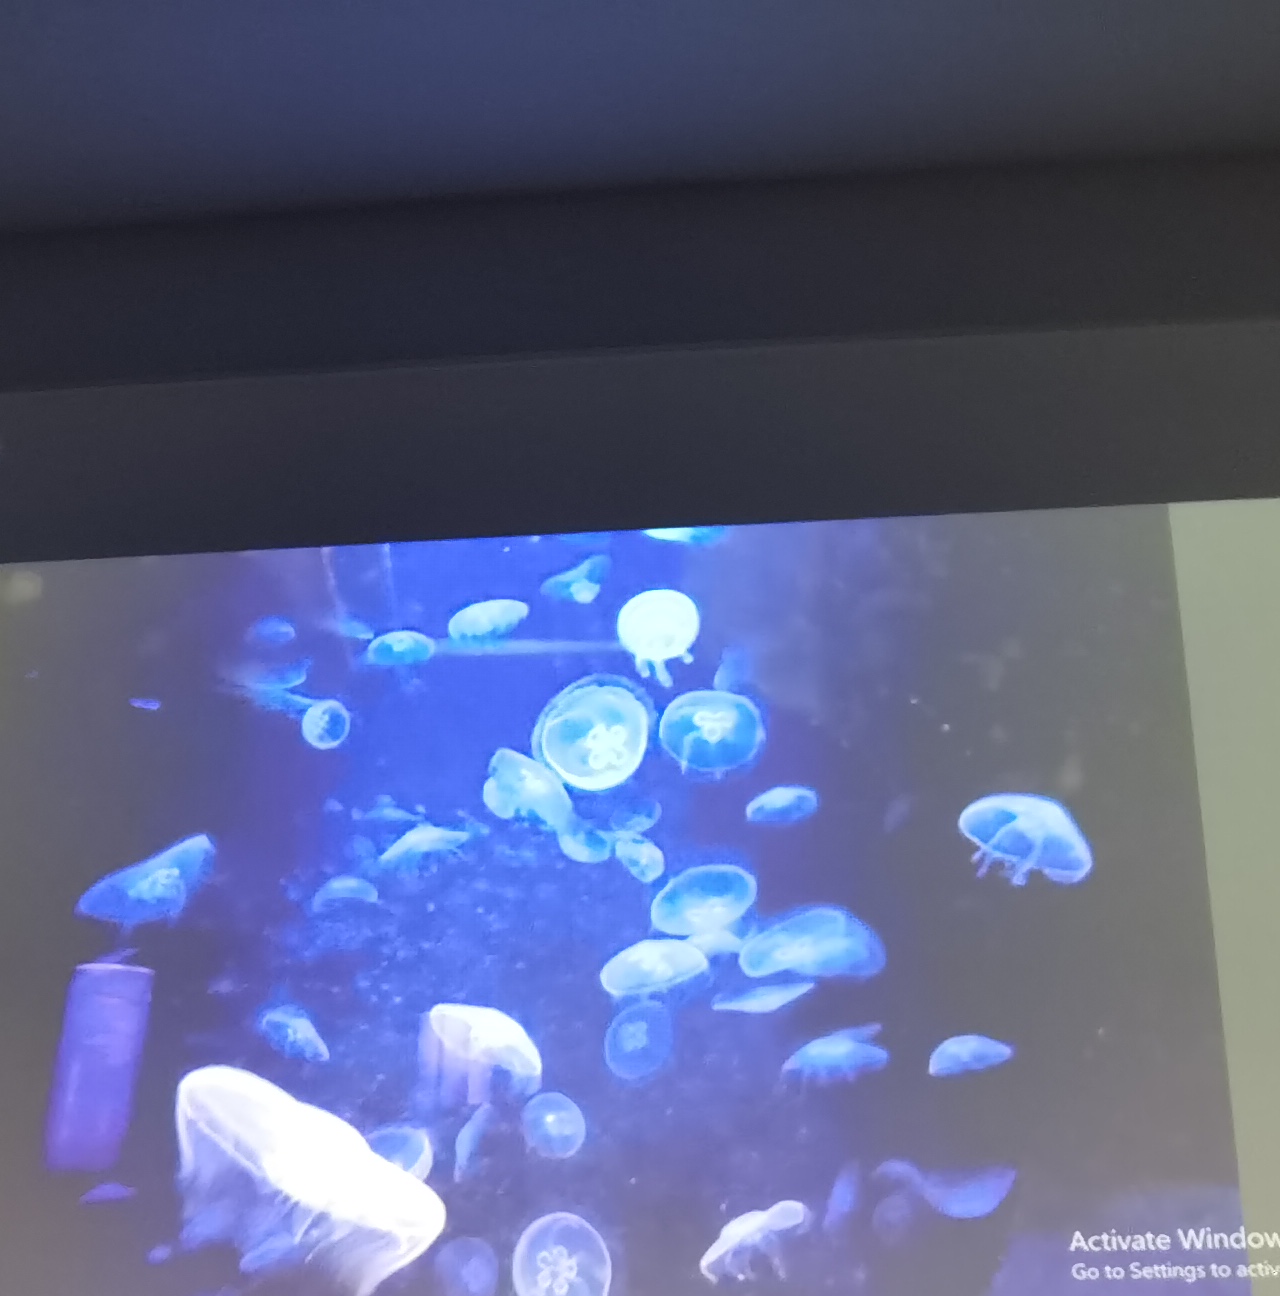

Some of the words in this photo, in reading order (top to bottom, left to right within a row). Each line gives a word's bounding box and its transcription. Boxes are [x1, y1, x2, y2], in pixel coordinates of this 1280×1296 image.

[1070, 1228, 1171, 1251] Activate
[1071, 1262, 1100, 1281] Go
[1104, 1264, 1126, 1280] to
[1129, 1261, 1207, 1284] Settings
[1209, 1262, 1232, 1279] to
